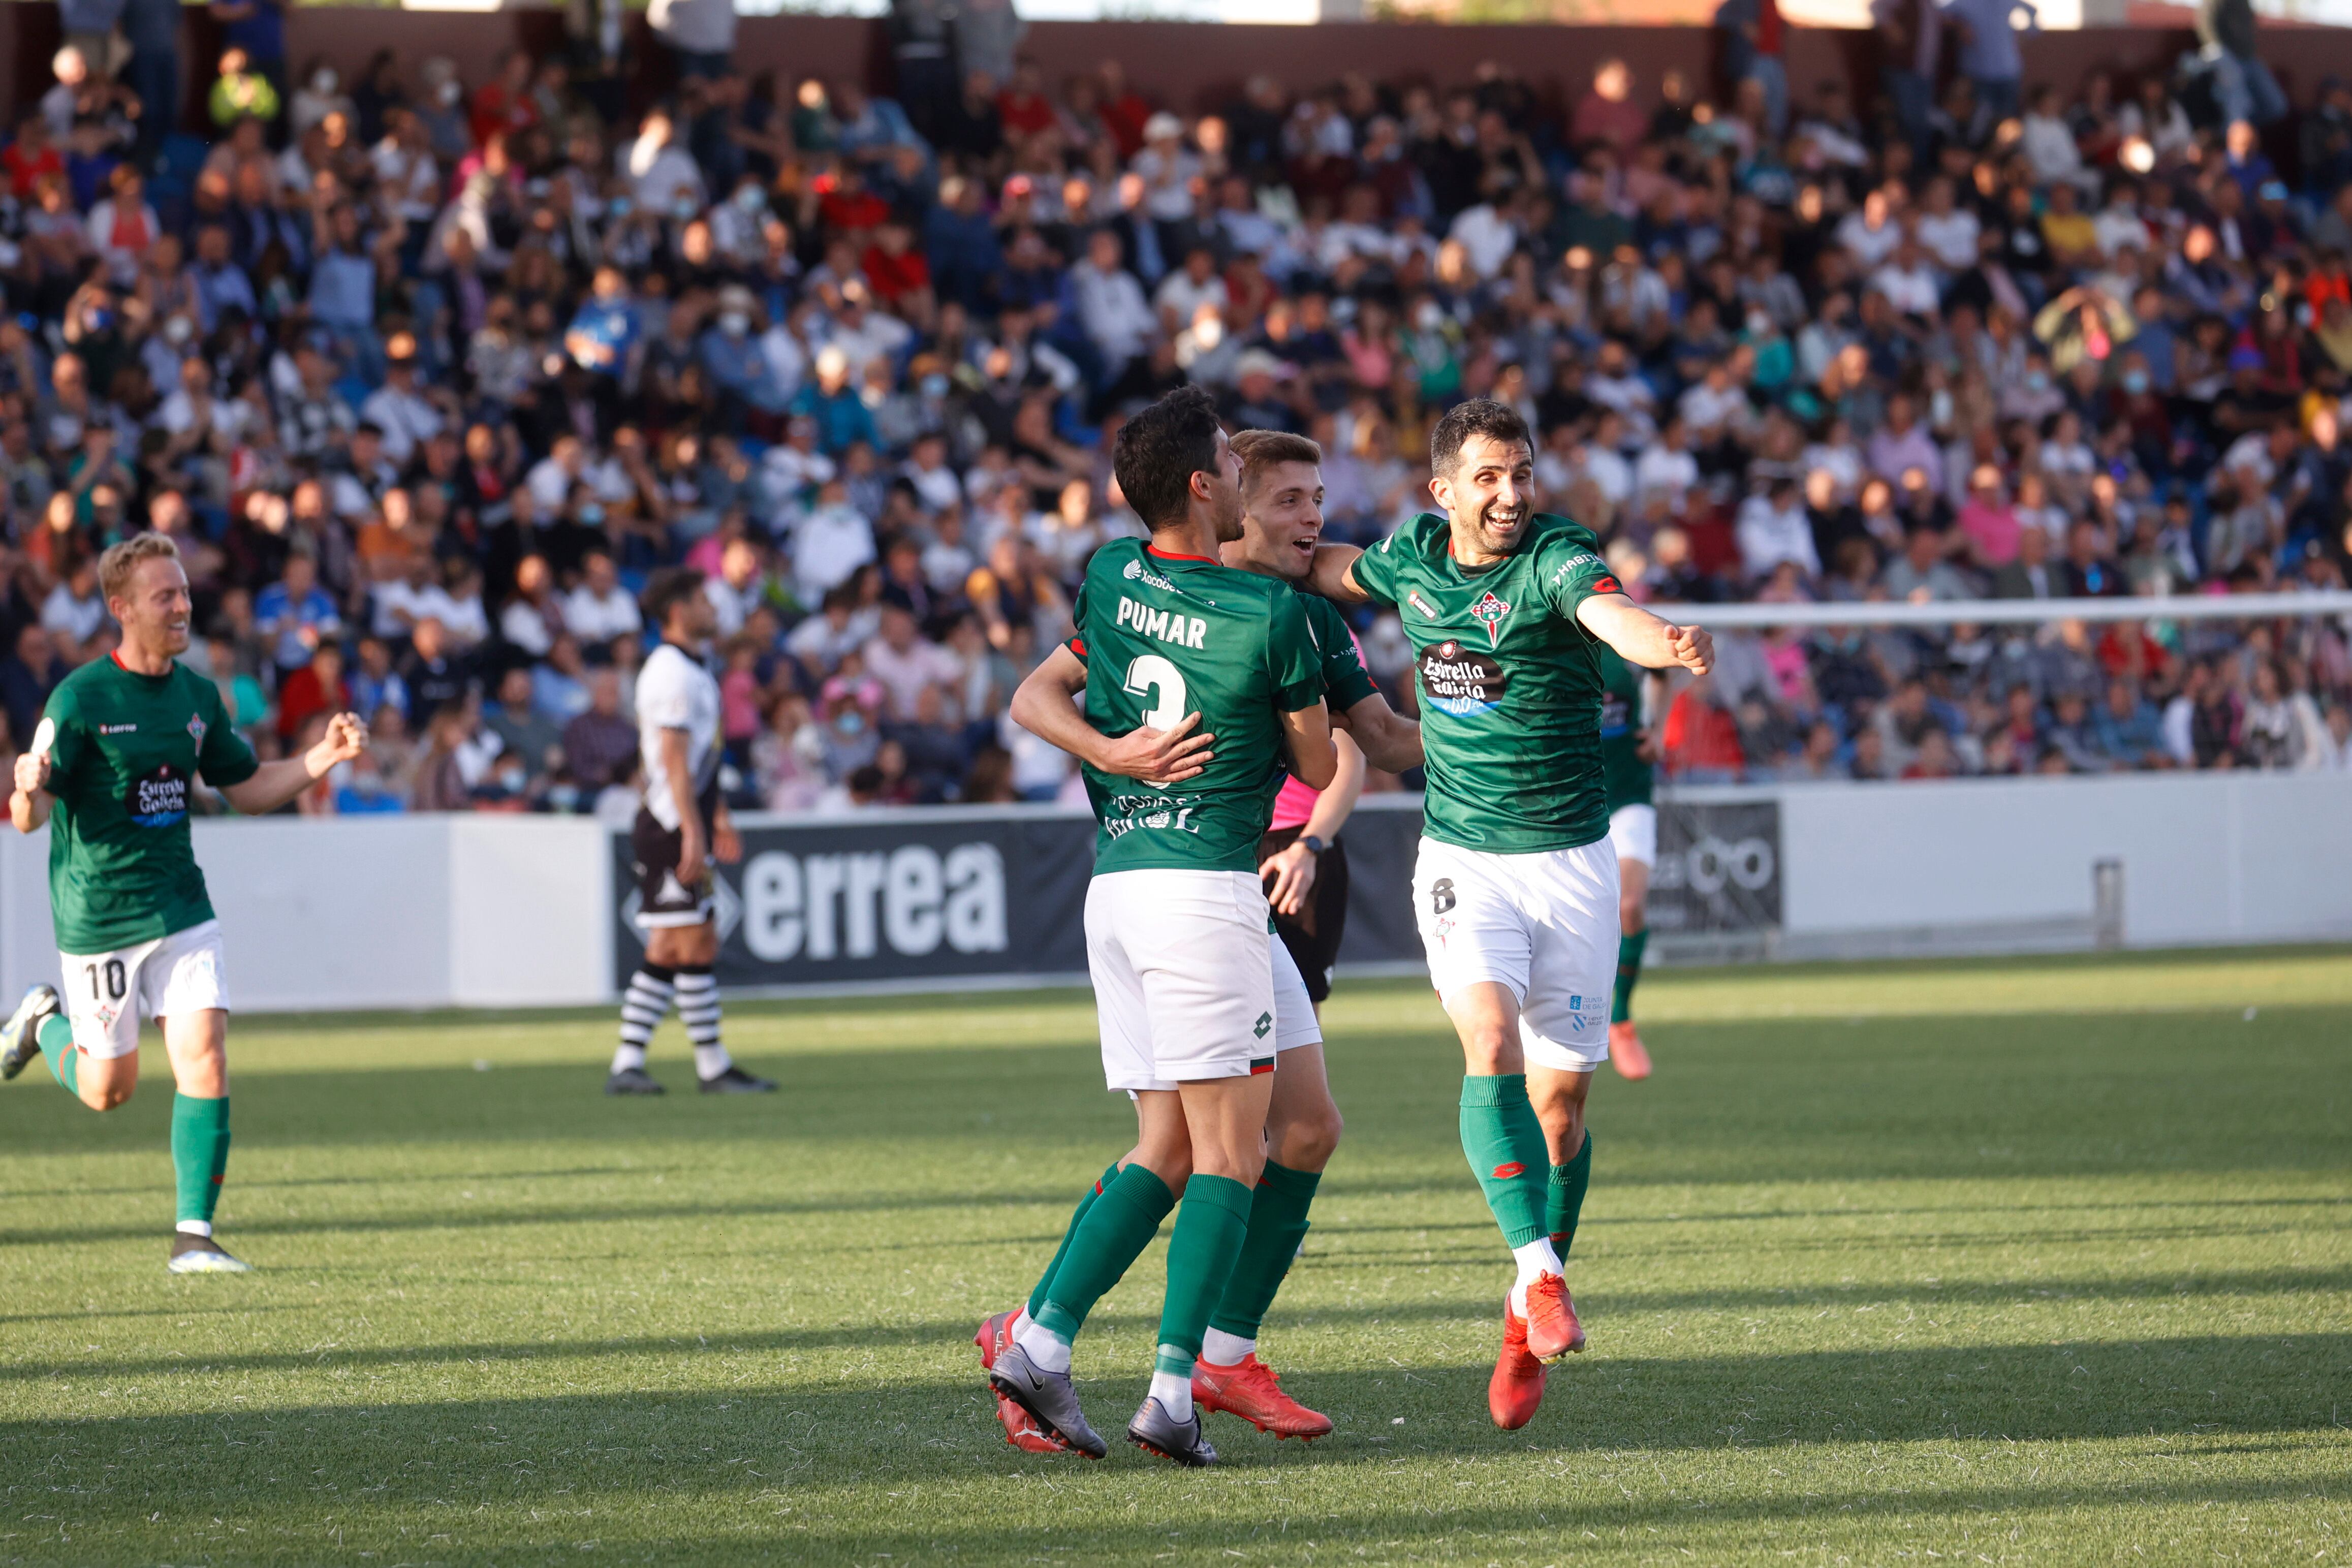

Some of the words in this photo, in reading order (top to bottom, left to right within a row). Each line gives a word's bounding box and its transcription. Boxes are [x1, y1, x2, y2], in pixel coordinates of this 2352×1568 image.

[1116, 595, 1207, 649] PUMAR
[1423, 656, 1486, 680] Estrella
[742, 842, 1010, 962] errea
[1429, 877, 1456, 917] 6
[86, 959, 127, 1000] 10
